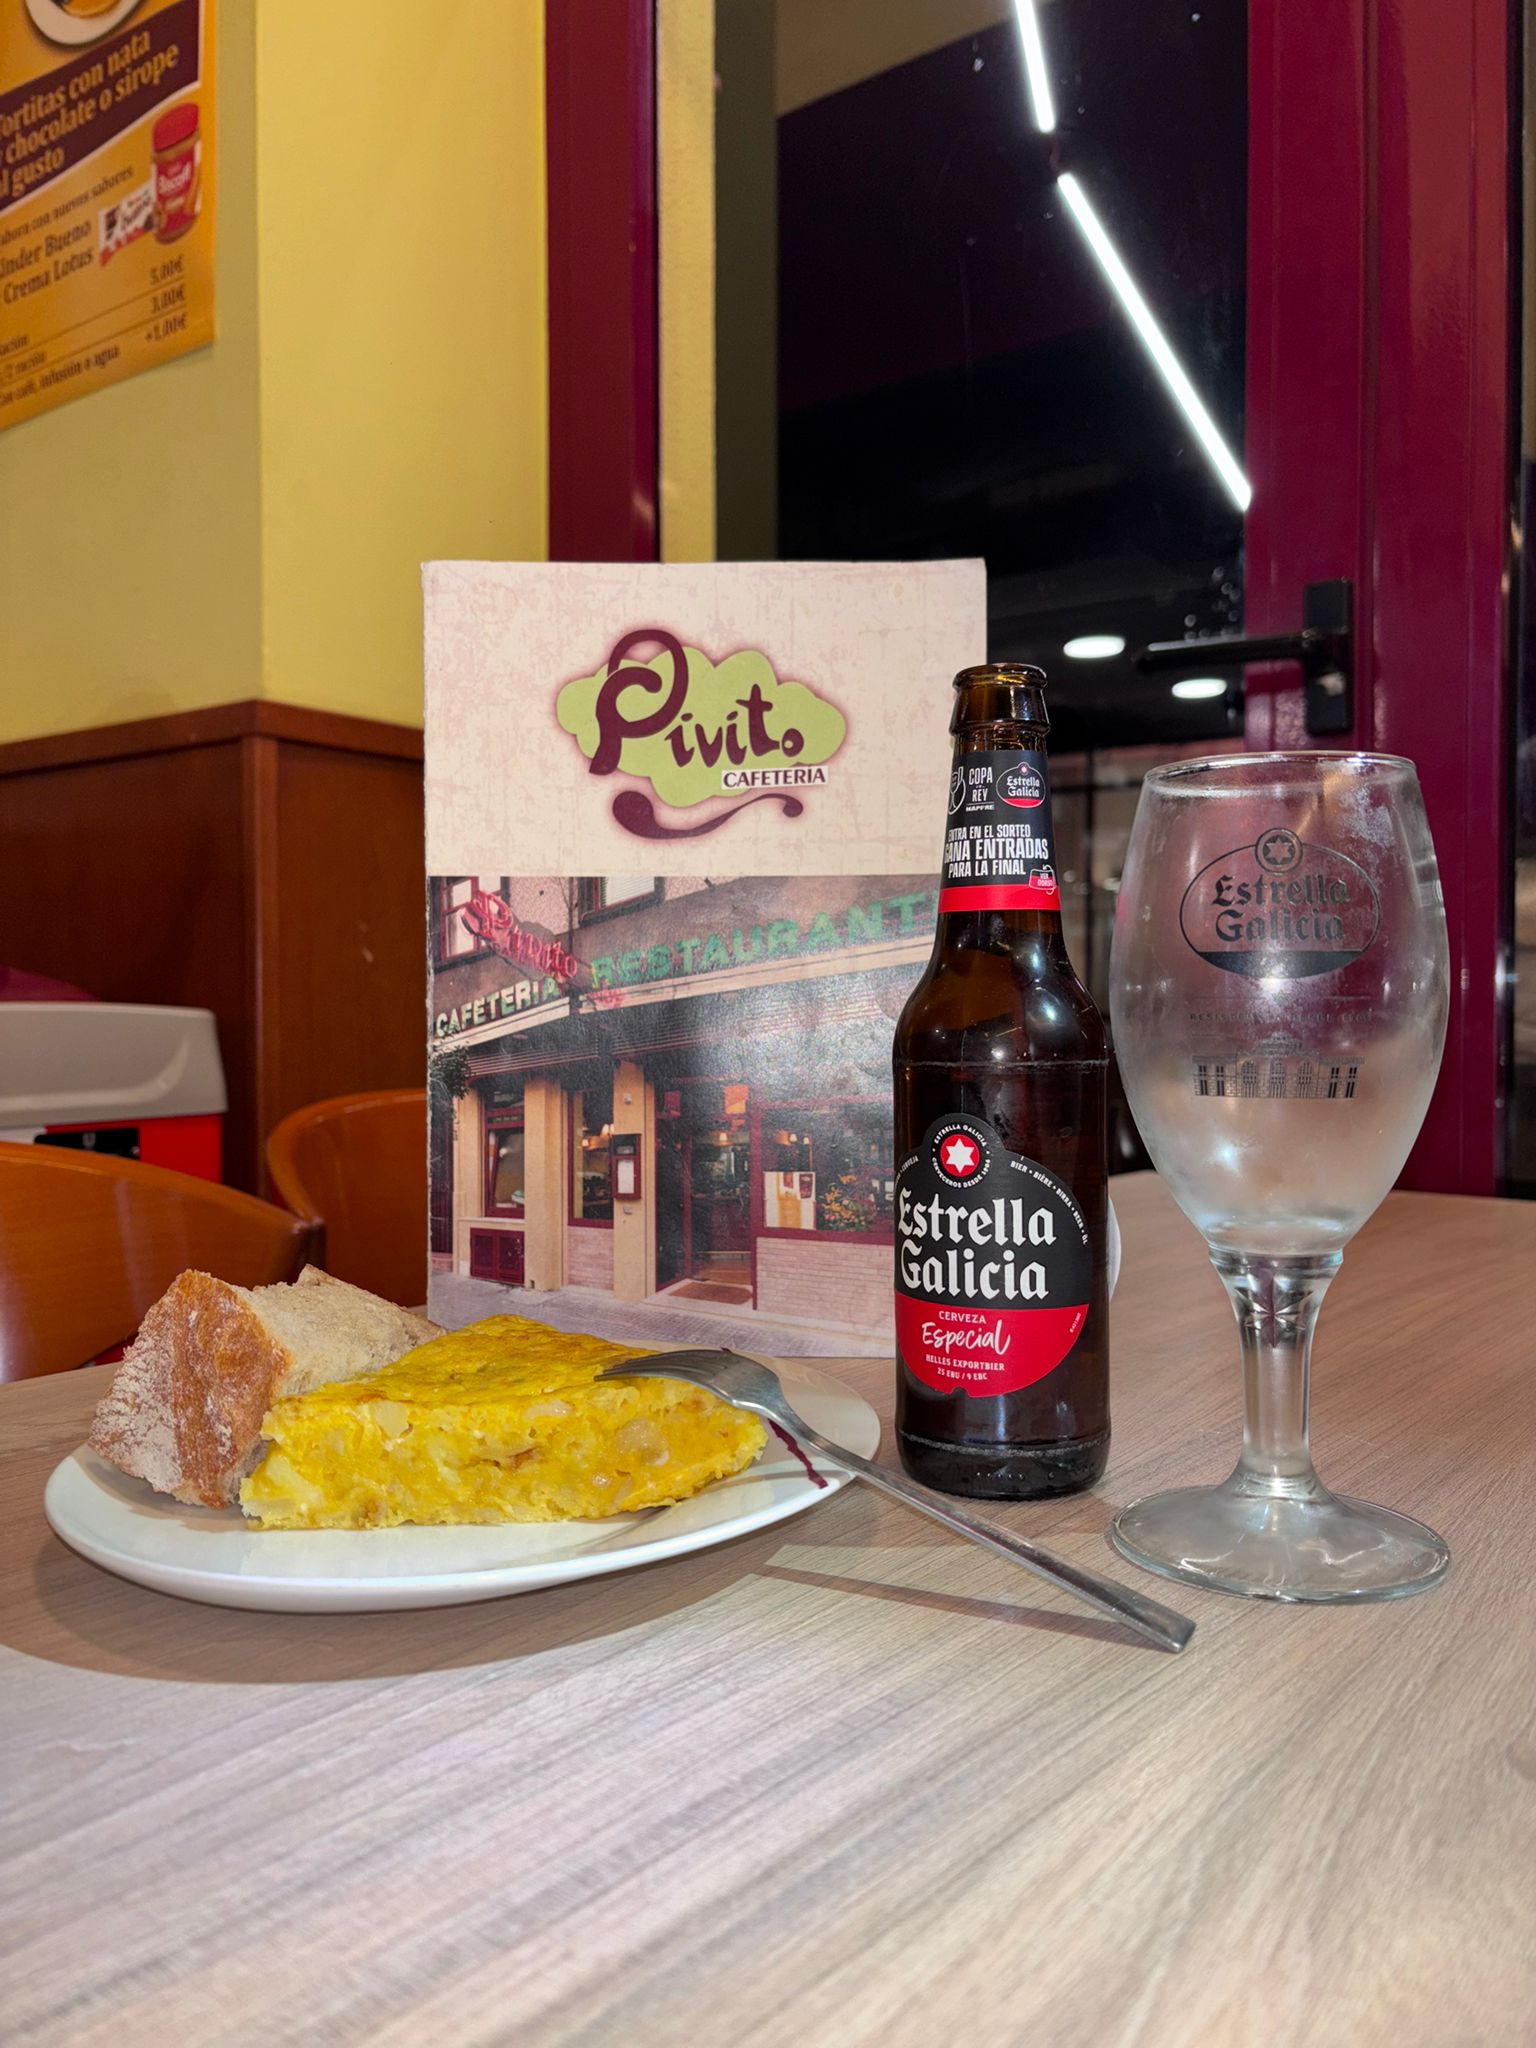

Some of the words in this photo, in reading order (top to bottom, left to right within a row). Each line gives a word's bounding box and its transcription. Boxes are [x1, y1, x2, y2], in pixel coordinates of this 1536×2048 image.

[0, 86, 66, 137] ortitas
[69, 62, 104, 100] con
[107, 31, 150, 76] nata
[5, 96, 97, 165] chocolate
[99, 88, 112, 112] o
[114, 44, 179, 102] sirope
[11, 147, 65, 198] gusto
[0, 245, 42, 278] inder
[44, 220, 92, 258] Bueno
[3, 270, 50, 305] Crema
[53, 247, 94, 282] Lotus
[588, 629, 805, 776] Pivito
[723, 767, 827, 788] CAFETERIA
[968, 767, 993, 785] COPA
[1007, 775, 1040, 787] Estrella
[972, 788, 988, 802] REY
[1007, 786, 1040, 798] Galicia
[966, 804, 995, 812] MAPFRE
[969, 825, 982, 839] EN
[984, 824, 994, 838] EL
[996, 823, 1031, 838] SORTEO
[975, 837, 1049, 860] ENTRADAS
[948, 860, 972, 879] PARA
[974, 859, 989, 877] LA
[992, 859, 1026, 876] FINAL
[1212, 874, 1350, 907] Estrella
[1215, 908, 1345, 943] Galicia
[591, 892, 939, 987] RESTAURANT
[436, 976, 562, 1037] CAFETERIA
[934, 1124, 961, 1145] ESTRELLA
[962, 1124, 988, 1147] GALICIA
[932, 1157, 962, 1188] CERVECEROS
[963, 1174, 983, 1189] DESDE
[1010, 1160, 1028, 1173] BIER
[898, 1187, 1057, 1247] Estrella
[900, 1239, 1049, 1300] Galicia
[938, 1310, 987, 1325] CERVEZA
[921, 1319, 1011, 1355] Especial
[926, 1353, 951, 1367] HELLES
[953, 1358, 1005, 1371] EXPORTBIER
[937, 1367, 945, 1376] 25
